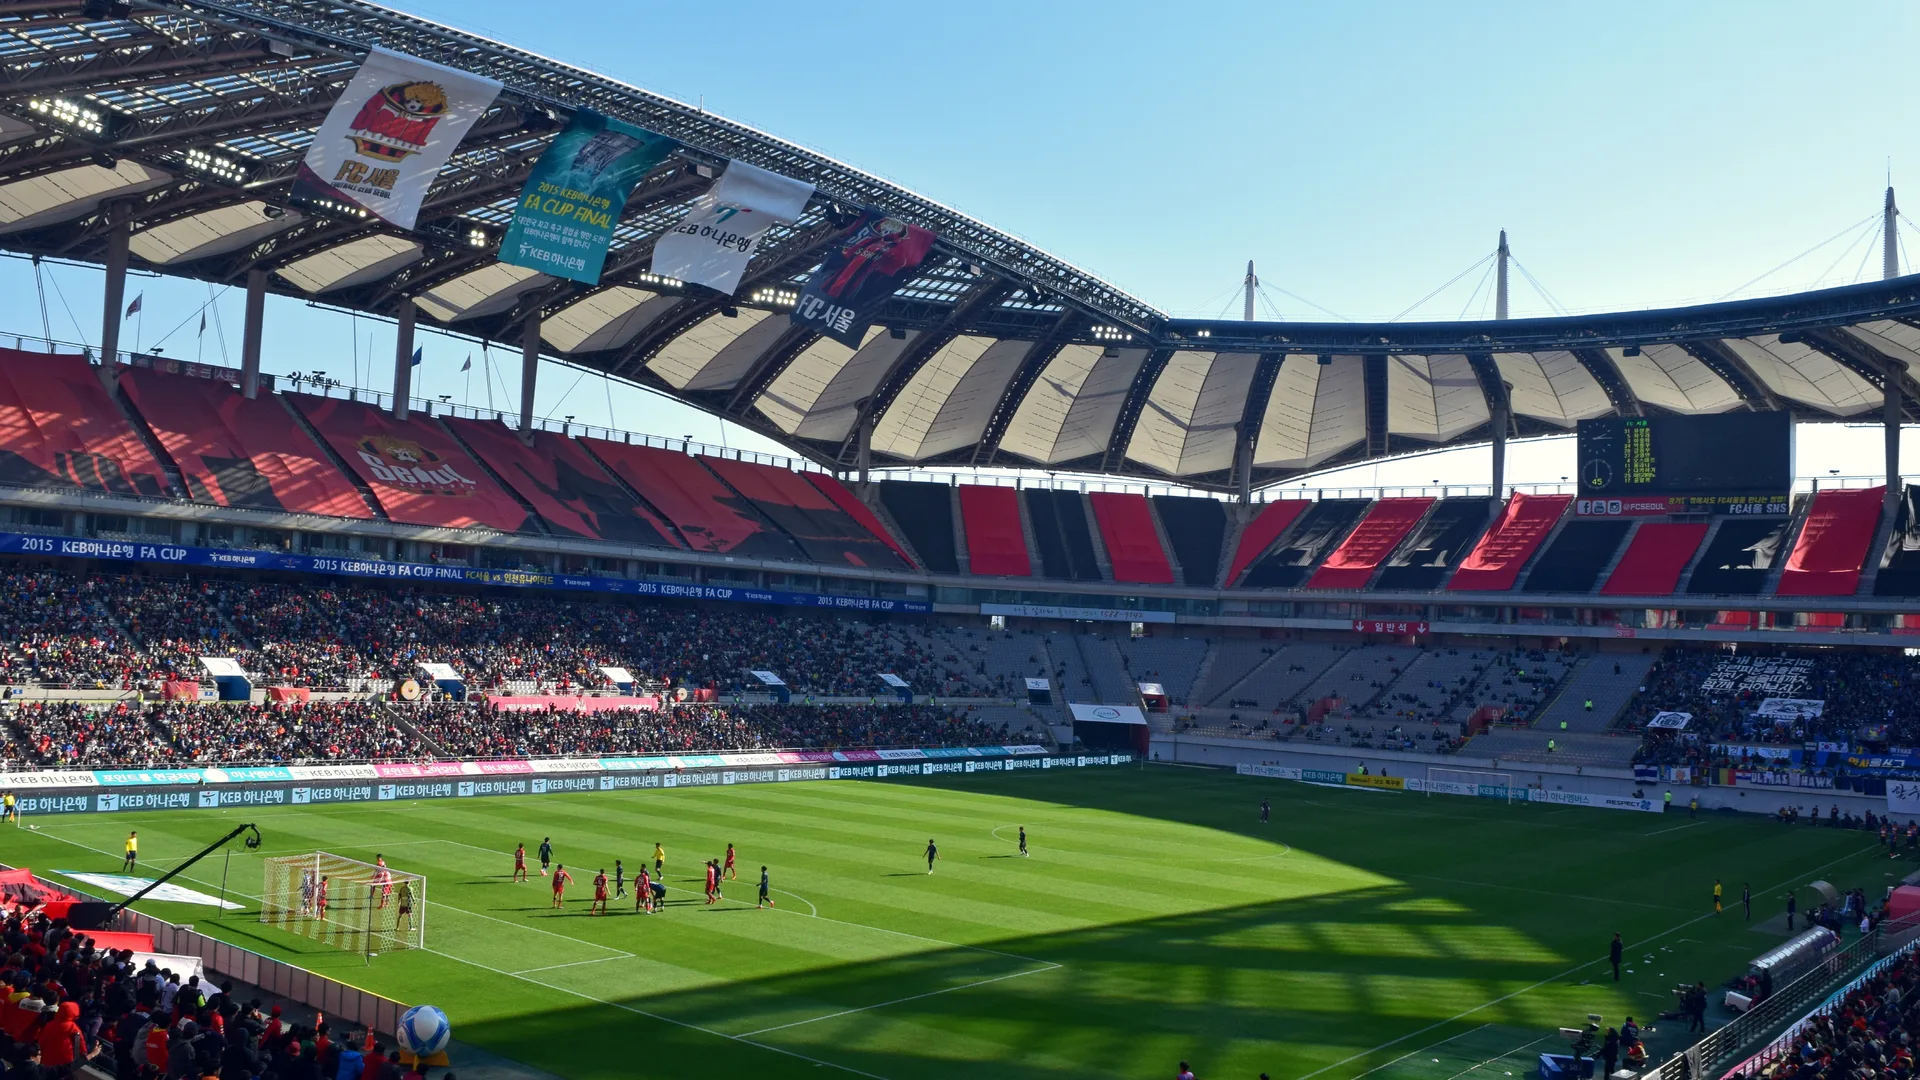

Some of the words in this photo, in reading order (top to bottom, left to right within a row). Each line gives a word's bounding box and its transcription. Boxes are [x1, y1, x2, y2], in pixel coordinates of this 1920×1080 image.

[334, 160, 369, 183] FC
[363, 168, 400, 190] 서울
[538, 182, 560, 195] 2015
[560, 189, 610, 210] KEB하나은행
[524, 194, 541, 210] FA
[543, 199, 574, 216] CUP
[573, 207, 611, 229] FINAL
[529, 248, 550, 261] KEB
[551, 253, 586, 271] 하나은행
[796, 293, 825, 320] FC
[818, 304, 855, 334] 서울
[1591, 478, 1603, 486] 45
[1623, 502, 1665, 511] @FCSEOUL
[1729, 504, 1762, 514] FC서울
[1766, 503, 1787, 513] SNS
[21, 537, 54, 552] 2015
[62, 540, 134, 559] KEB하나은행
[140, 547, 157, 560] FA
[160, 549, 187, 561] CUP
[232, 555, 256, 565] 하나은행
[312, 559, 338, 571] 2015
[340, 561, 396, 576] KEB하나은행
[398, 565, 411, 576] FA
[413, 566, 433, 578] CUP
[435, 568, 463, 580] FINAL
[465, 571, 490, 583] FC서울
[638, 583, 656, 593] 2015
[661, 585, 702, 597] KEB하나은행
[705, 588, 715, 598] FA
[717, 589, 733, 599] CUP
[817, 596, 833, 605] 2015
[871, 600, 881, 609] FA
[881, 601, 895, 610] CUP
[789, 769, 802, 779] KEB
[802, 769, 826, 780] 하나은행
[840, 768, 852, 776] KEB
[853, 766, 874, 777] 하나은행
[888, 766, 898, 774] KEB
[933, 764, 943, 772] KEB
[615, 777, 630, 786] KEB
[631, 775, 659, 788] 하나은행
[678, 774, 691, 784] KEB
[693, 773, 718, 785] 하나은행
[735, 772, 748, 782] KEB
[750, 771, 774, 781] 하나은행
[1303, 771, 1316, 780] KEB
[1318, 772, 1343, 783] 하나은행
[396, 785, 415, 796] KEB
[417, 783, 451, 797] 하나은행
[475, 782, 492, 793] KEB
[493, 781, 526, 794] 하나은행
[547, 780, 563, 790] KEB
[565, 778, 595, 790] 하나은행
[220, 791, 242, 803] KEB
[244, 790, 284, 804] 하나은행
[312, 788, 332, 800] KEB
[333, 786, 371, 800] 하나은행
[1480, 787, 1495, 795] KEB
[40, 796, 88, 812] 하나은행
[120, 795, 144, 807] KEB
[147, 793, 190, 809] 하나은행
[1606, 799, 1640, 807] RESPECT
